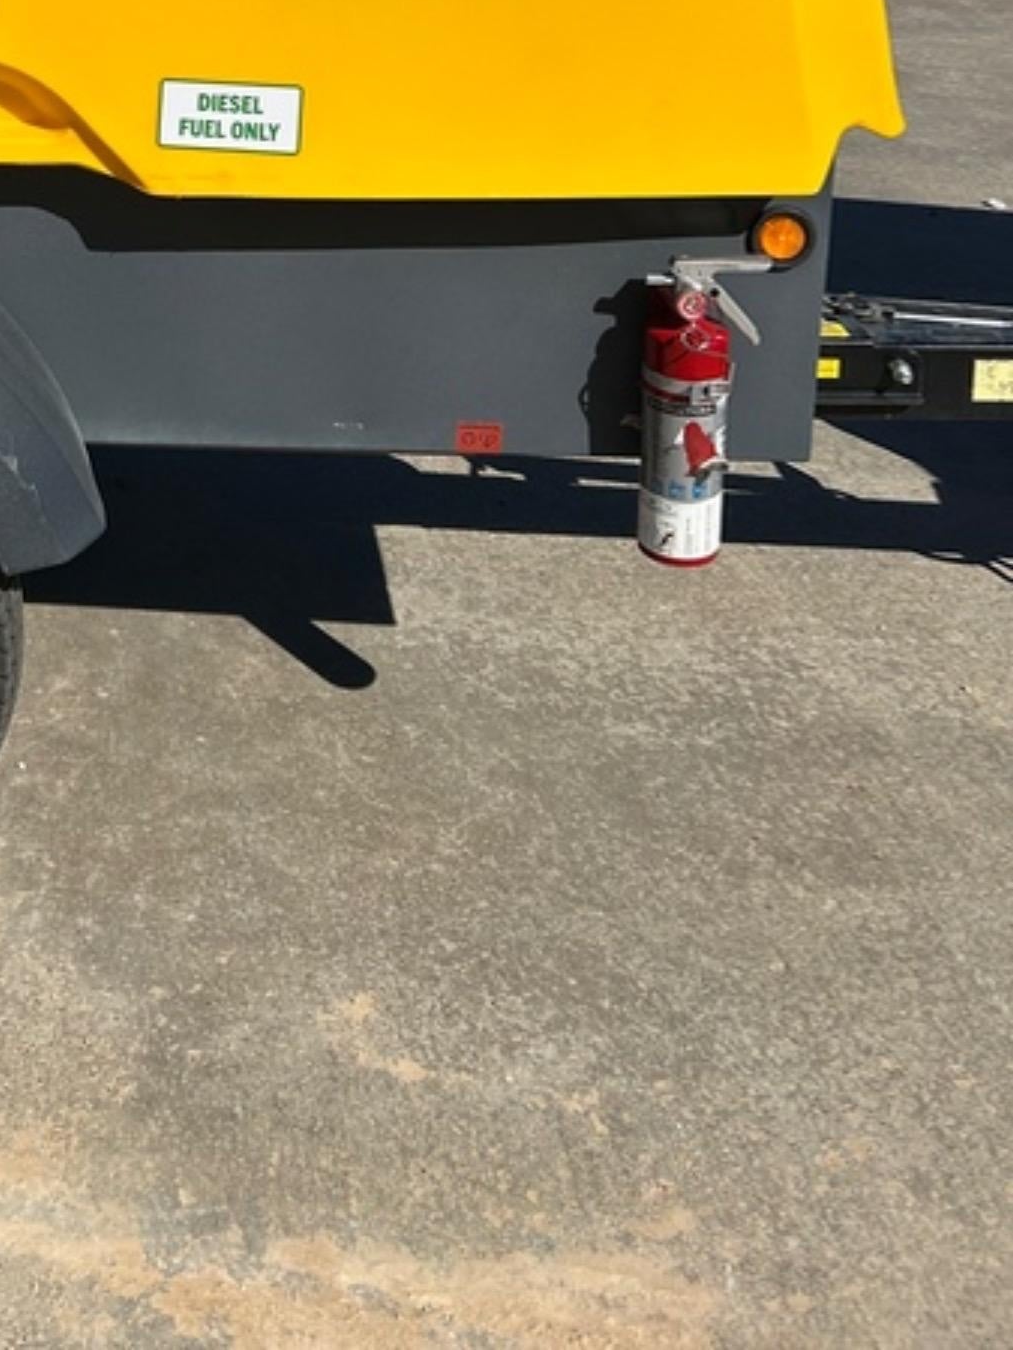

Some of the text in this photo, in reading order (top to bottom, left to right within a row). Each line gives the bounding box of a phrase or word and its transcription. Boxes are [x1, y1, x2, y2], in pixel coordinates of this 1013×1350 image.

[196, 93, 264, 115] DIESEL
[178, 118, 281, 142] FUEL ONLY
